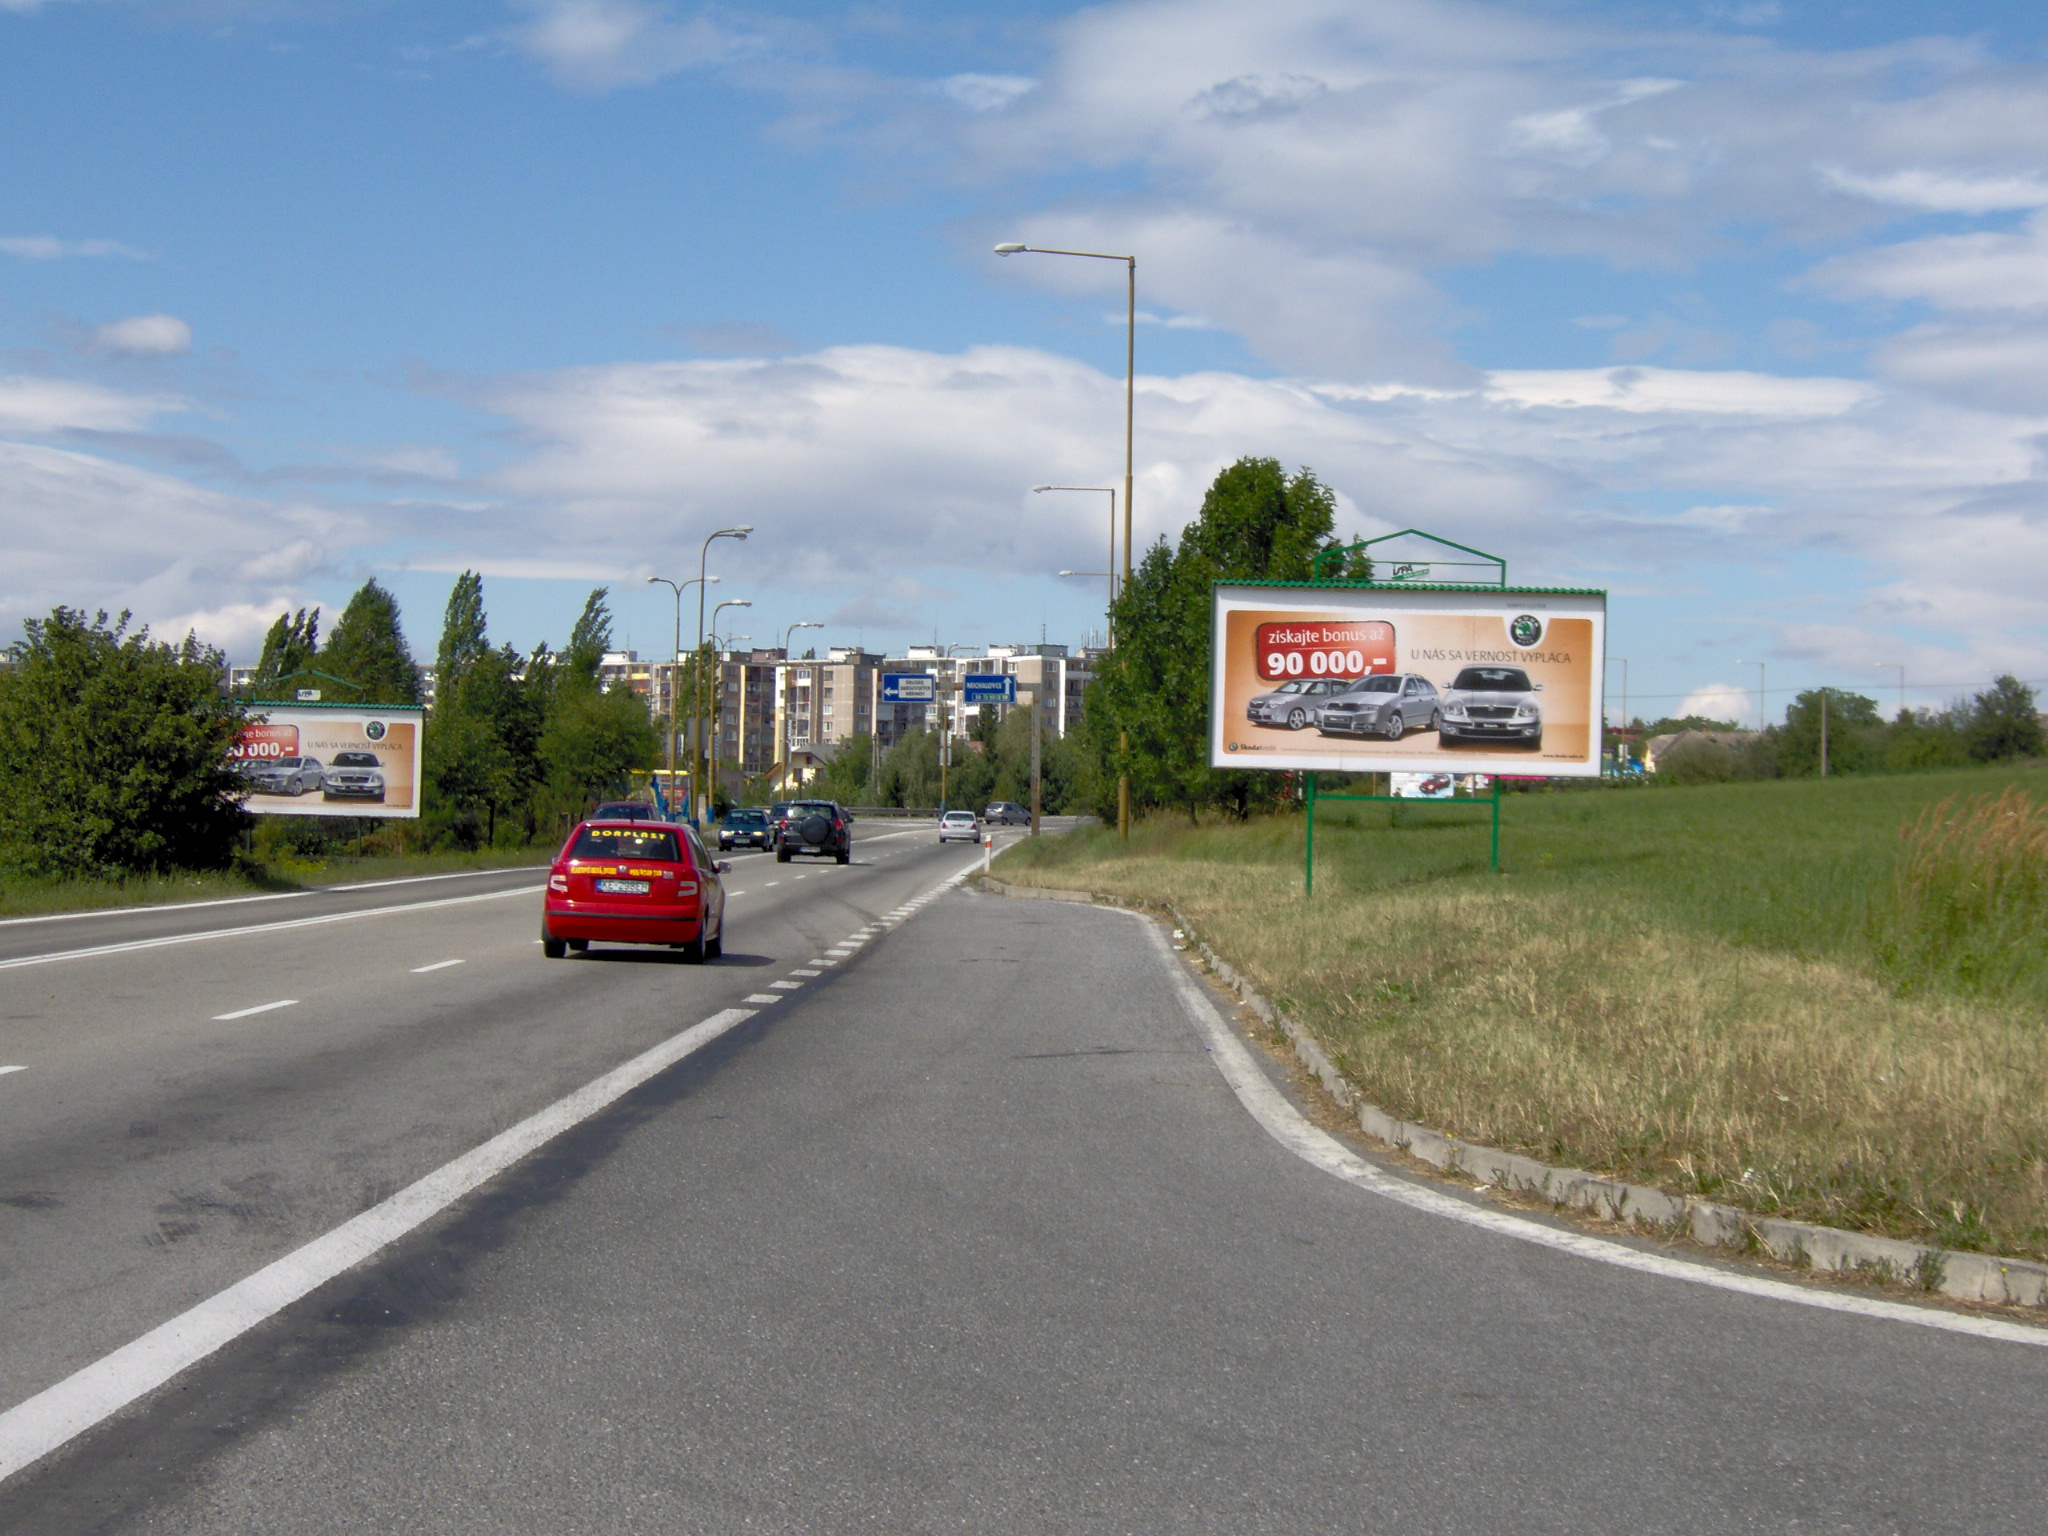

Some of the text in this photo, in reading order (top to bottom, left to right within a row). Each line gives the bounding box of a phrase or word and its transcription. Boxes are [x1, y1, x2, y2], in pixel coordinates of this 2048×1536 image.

[1323, 627, 1366, 642] bonus
[1369, 627, 1385, 641] až
[1411, 650, 1419, 659] U
[1423, 647, 1446, 660] NÁS
[1448, 650, 1462, 661] SA
[1267, 650, 1387, 675] 90 000,-
[591, 830, 666, 840] DORPLAST
